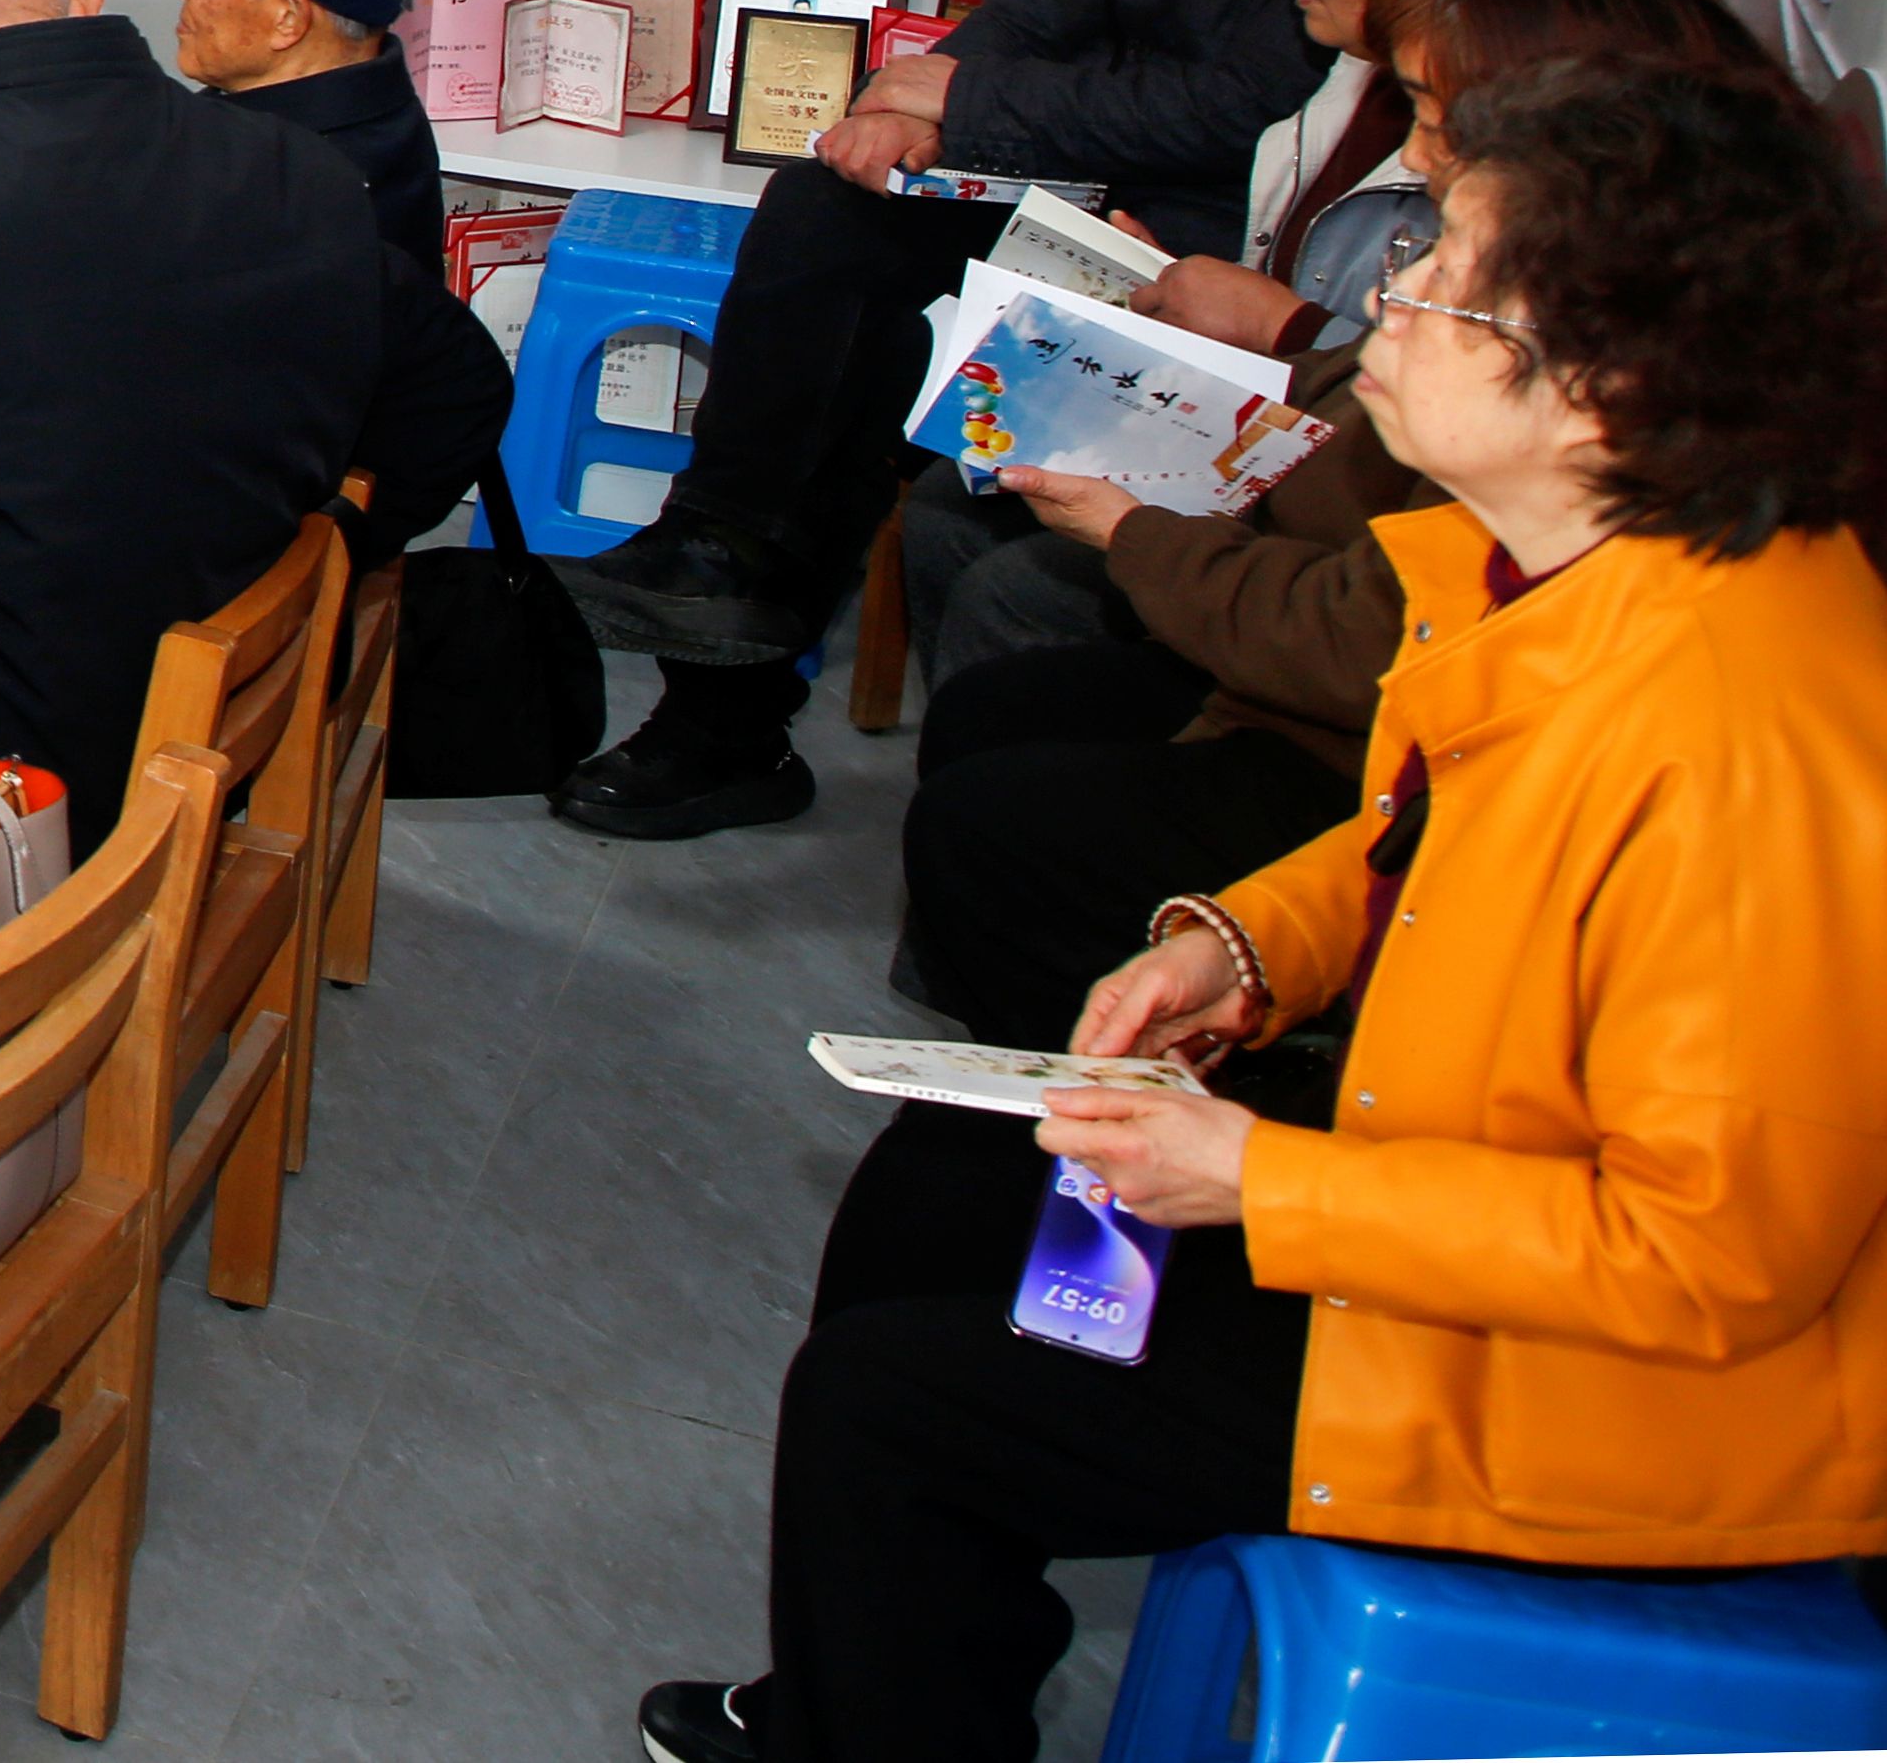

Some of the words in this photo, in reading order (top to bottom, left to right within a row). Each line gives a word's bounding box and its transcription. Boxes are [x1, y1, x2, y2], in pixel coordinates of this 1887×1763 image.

[771, 103, 820, 121] 三等奖
[1042, 1283, 1127, 1325] 09:57
